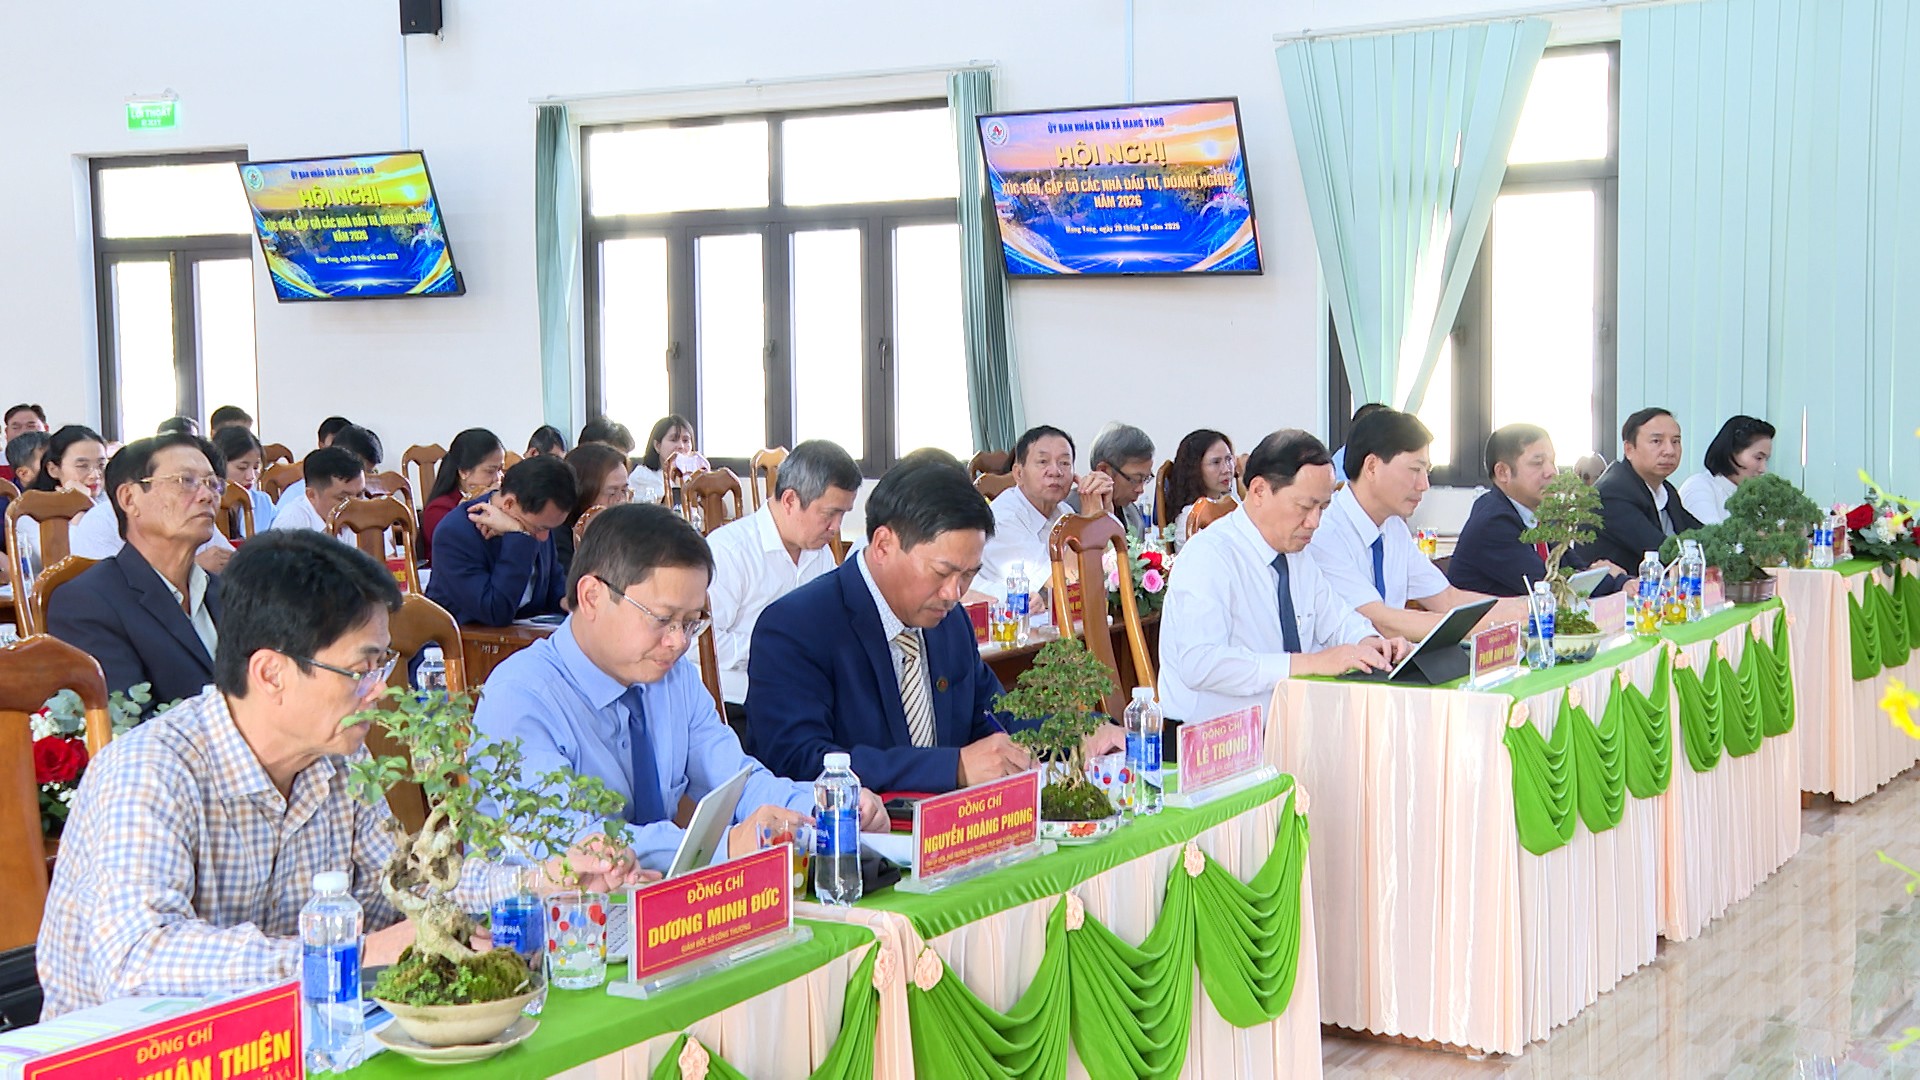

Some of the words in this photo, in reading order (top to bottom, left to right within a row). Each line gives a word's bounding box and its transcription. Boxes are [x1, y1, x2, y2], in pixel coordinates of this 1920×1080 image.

[1059, 122, 1073, 133] BAN
[1123, 119, 1144, 129] MANG
[1055, 139, 1100, 171] HỘI
[1104, 140, 1167, 167] NGHỊ
[298, 184, 333, 211] HỘI
[333, 186, 382, 208] NGHỊ
[1081, 176, 1101, 193] CÁC
[1102, 175, 1123, 192] NHÀ
[1163, 175, 1198, 190] DOANH
[1094, 194, 1116, 209] NĂM
[1117, 195, 1143, 208] 2026
[1196, 743, 1209, 767] LÊ
[1212, 735, 1248, 762] TRỌNG
[958, 798, 986, 818] ĐỒNG
[987, 792, 1003, 810] CHÍ
[966, 818, 999, 841] HOÀNG
[1001, 807, 1033, 830] PHONG
[687, 880, 723, 904] ĐỒNG
[725, 870, 744, 892] CHÍ
[648, 912, 703, 948] DƯƠNG
[707, 897, 748, 929] MINH
[751, 887, 780, 914] ĐỨC
[136, 1034, 184, 1064] ĐỒNG
[187, 1022, 214, 1047] CHÍ
[218, 1029, 292, 1079] THIỆN
